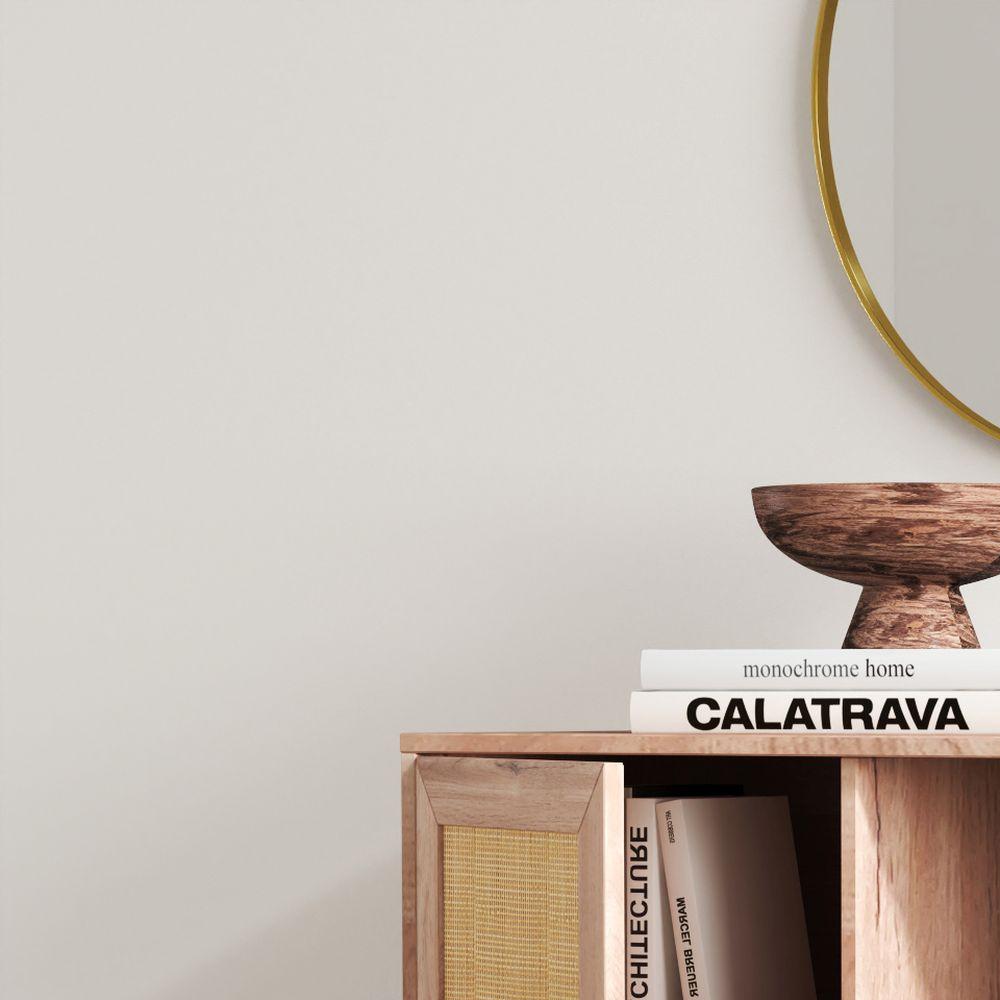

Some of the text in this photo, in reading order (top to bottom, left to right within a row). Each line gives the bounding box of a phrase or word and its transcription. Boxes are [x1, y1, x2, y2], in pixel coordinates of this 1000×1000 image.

[743, 657, 915, 679] monochrome home
[686, 697, 970, 732] CALATRAVA
